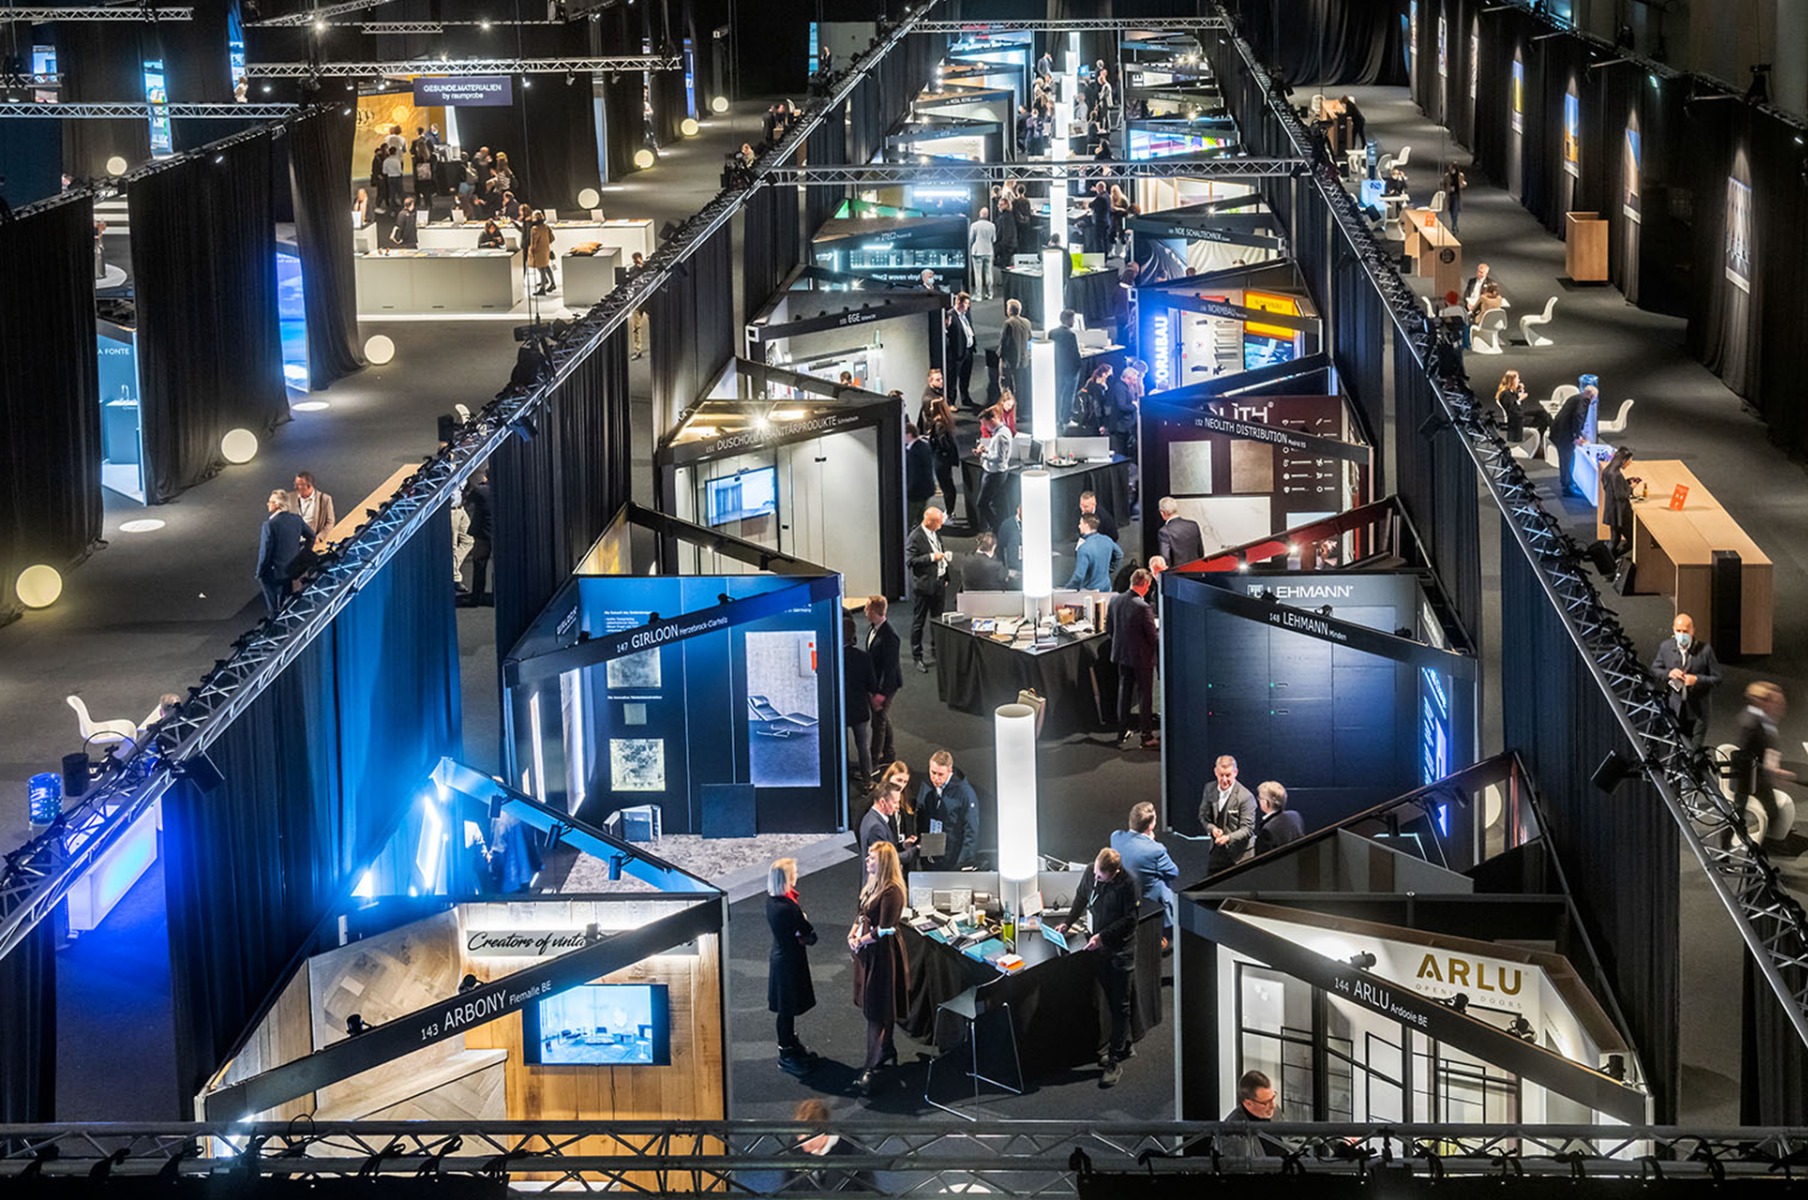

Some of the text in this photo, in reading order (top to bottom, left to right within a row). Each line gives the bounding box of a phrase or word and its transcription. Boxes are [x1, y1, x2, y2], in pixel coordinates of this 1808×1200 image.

[848, 312, 860, 324] EGE
[104, 348, 130, 356] FONTE
[1204, 418, 1235, 432] NEOLITH
[1236, 426, 1288, 444] DISTRIBUTION
[616, 643, 628, 653] 147
[631, 624, 679, 649] GIRLOON
[1269, 612, 1347, 640] 148 LEHMANN Minden
[467, 932, 587, 956] Creators of vinta
[1416, 953, 1522, 996] ARLU
[420, 1023, 439, 1040] 143
[444, 990, 506, 1031] ARBONY
[541, 980, 552, 993] BE
[1334, 978, 1428, 1028] 144 ARLU Ardooie BE
[1480, 996, 1522, 1009] DOORS
